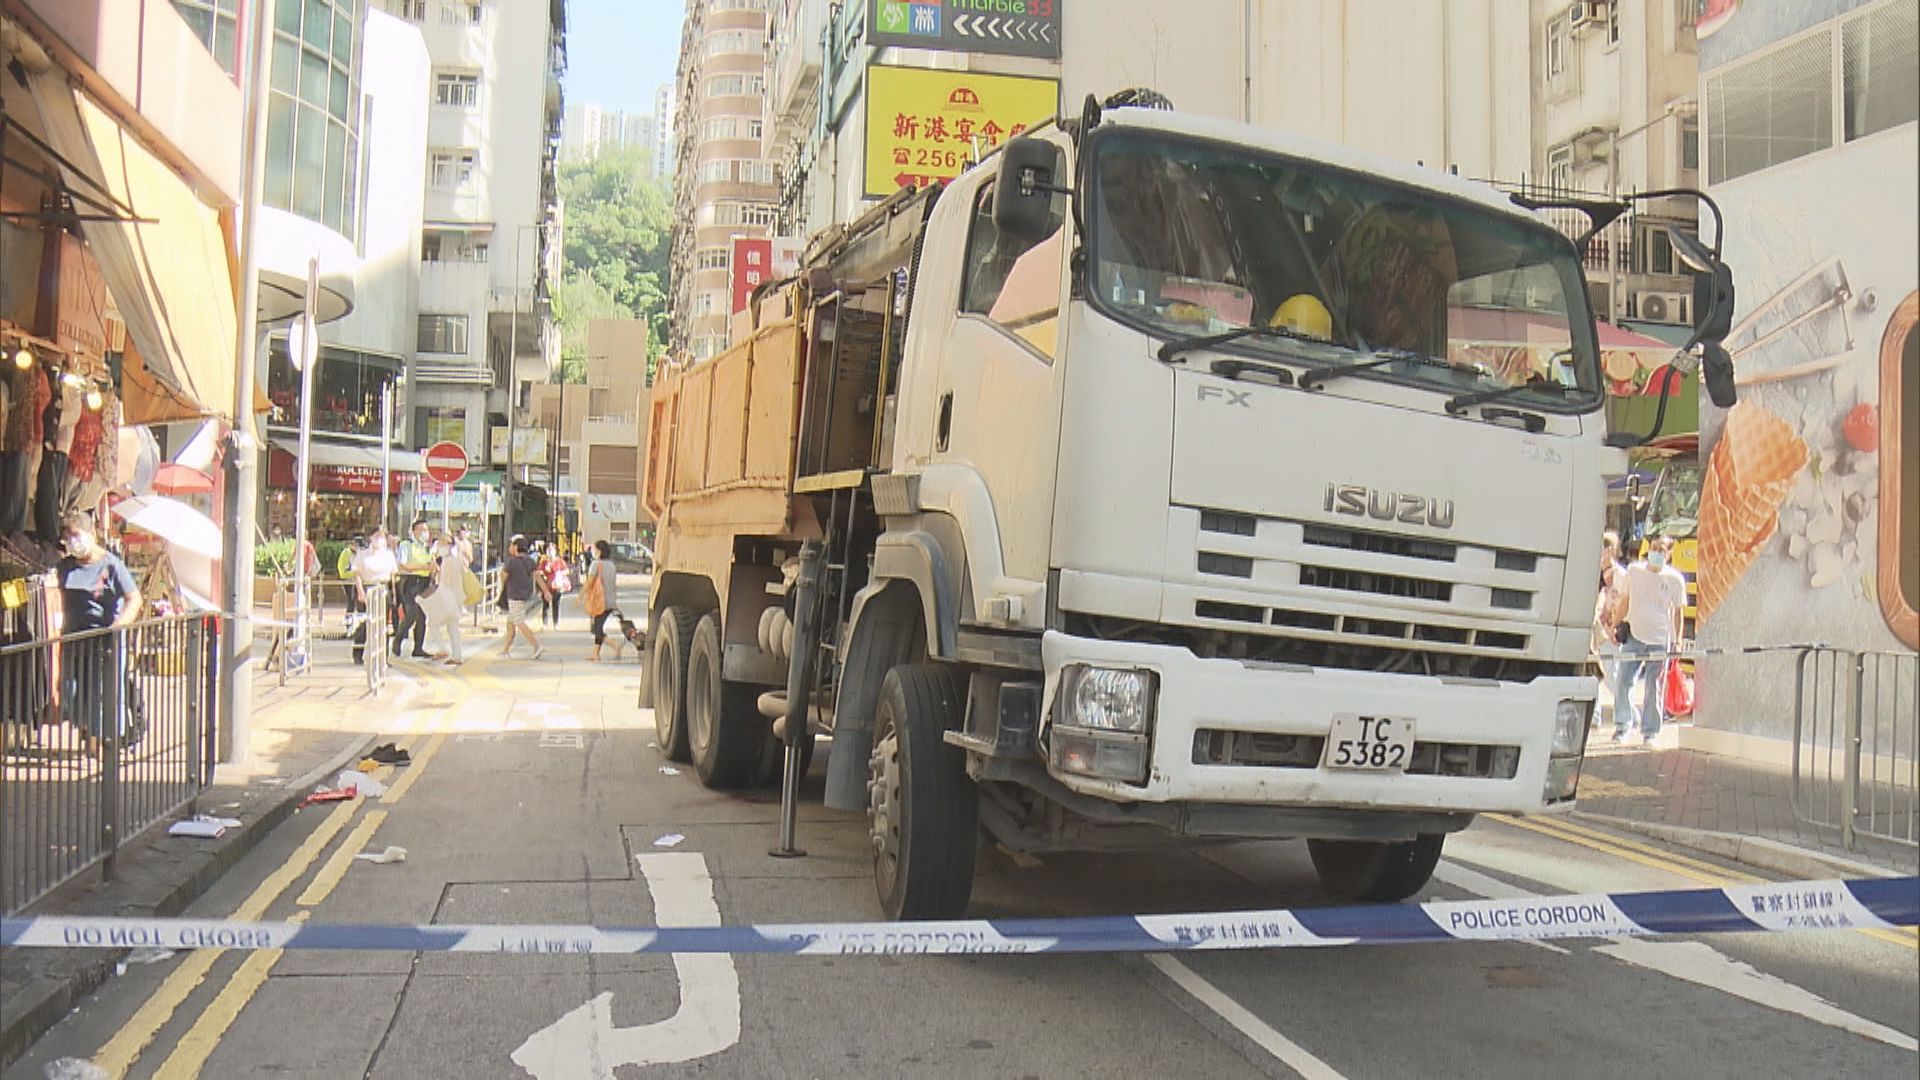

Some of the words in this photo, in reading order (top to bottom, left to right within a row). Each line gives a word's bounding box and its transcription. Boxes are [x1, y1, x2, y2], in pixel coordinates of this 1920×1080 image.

[1196, 384, 1253, 409] FX
[1322, 482, 1455, 530] ISUZU
[1358, 716, 1392, 742] TC
[1335, 740, 1406, 768] 5382
[1450, 909, 1521, 931] POLICE
[1525, 903, 1607, 926] CORDON
